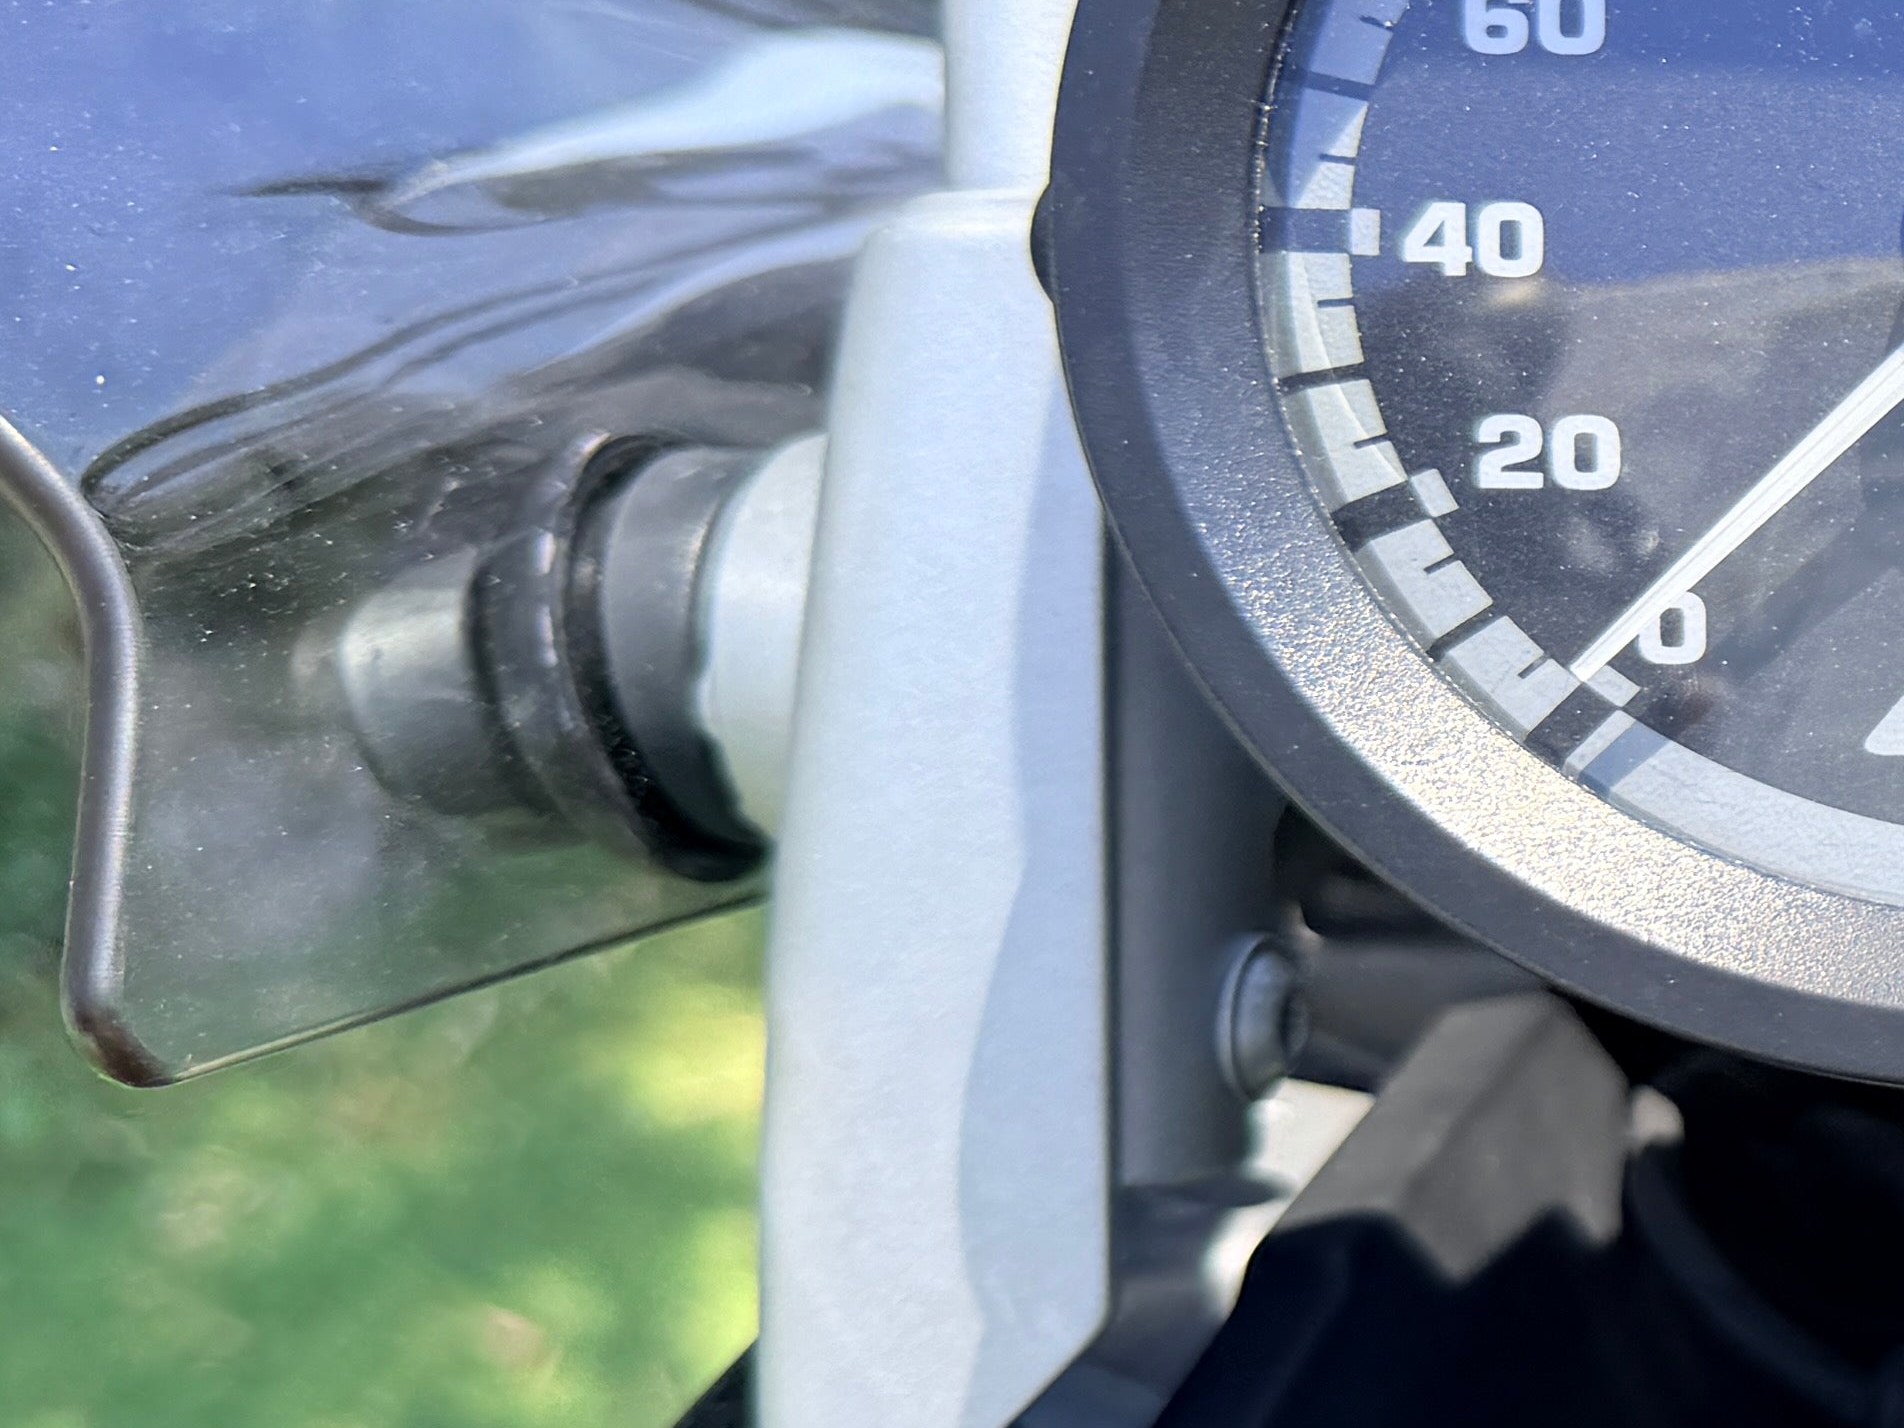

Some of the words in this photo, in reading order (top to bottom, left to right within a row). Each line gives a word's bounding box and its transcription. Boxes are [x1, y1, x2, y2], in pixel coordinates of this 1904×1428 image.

[1402, 202, 1545, 278] 40
[1472, 413, 1622, 492] 20
[1637, 590, 1707, 665] 0
